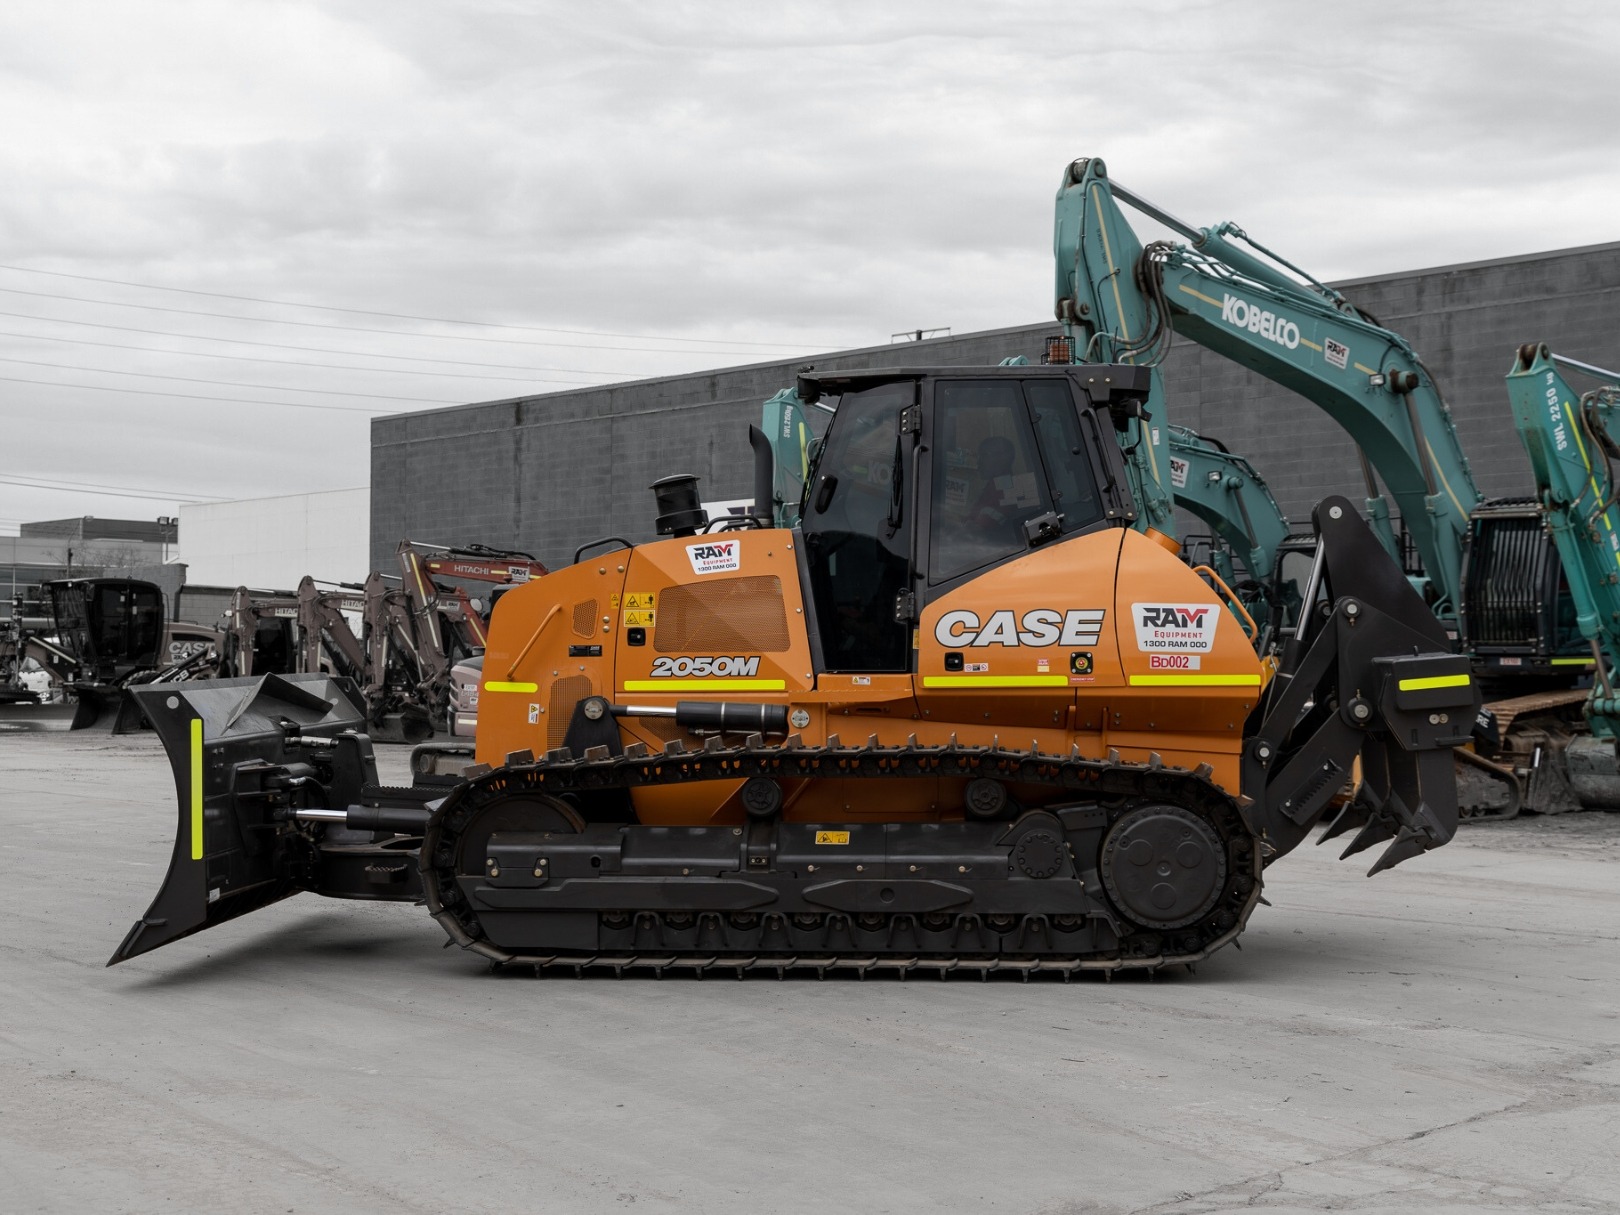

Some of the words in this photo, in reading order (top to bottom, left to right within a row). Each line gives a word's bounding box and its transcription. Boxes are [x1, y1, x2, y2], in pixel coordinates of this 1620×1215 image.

[1222, 293, 1300, 349] KOBELCO
[1327, 341, 1347, 357] RAM
[1546, 388, 1561, 421] 2250
[1554, 422, 1567, 451] SWL
[1170, 459, 1185, 474] AM
[693, 543, 733, 560] RAM
[454, 564, 489, 575] HITACHI
[275, 607, 298, 615] HITAC
[341, 599, 364, 608] HITAC
[1143, 607, 1209, 629] RAM
[934, 609, 1106, 648] CASE
[1154, 630, 1203, 639] EQUIPMENT
[1144, 640, 1166, 648] 1300
[1167, 640, 1188, 648] RAM
[1189, 641, 1207, 649] 000
[649, 656, 761, 678] 2050M
